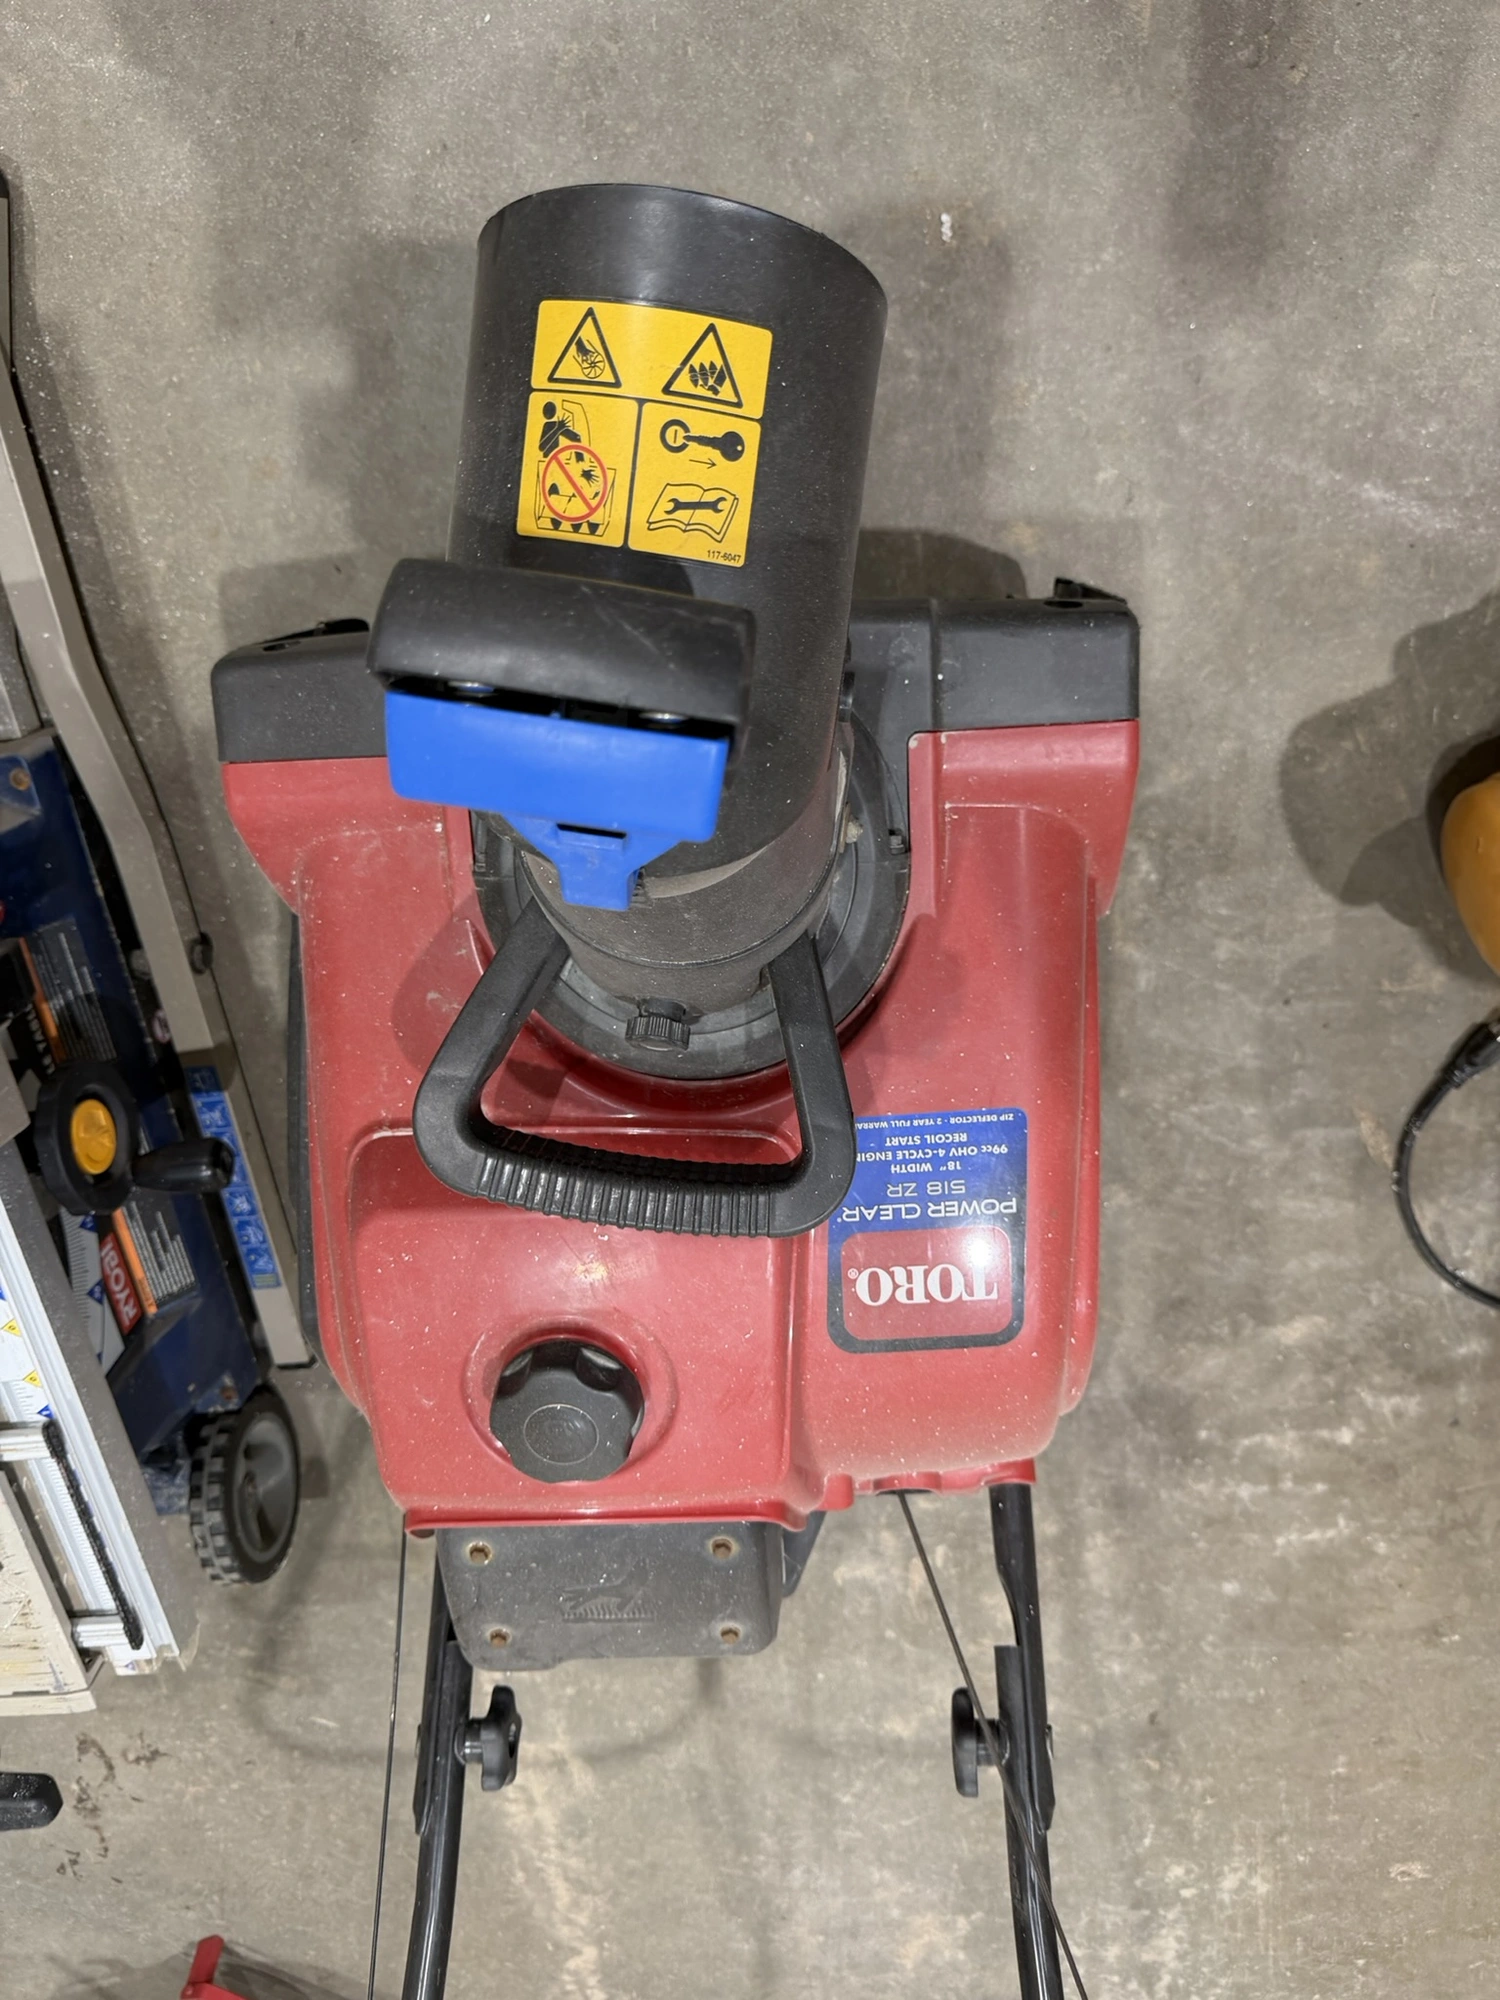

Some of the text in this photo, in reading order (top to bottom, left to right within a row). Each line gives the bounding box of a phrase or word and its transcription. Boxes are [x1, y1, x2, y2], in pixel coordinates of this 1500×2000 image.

[707, 550, 741, 563] 117-6047
[912, 1118, 935, 1126] YEAR
[950, 1114, 997, 1125] DEFLECTOR
[999, 1113, 1014, 1121] ZIP
[855, 1122, 888, 1130] WARRA
[890, 1120, 910, 1128] FULL
[885, 1132, 967, 1146] RECOIL START
[896, 1147, 945, 1160] 4-CYCLE
[949, 1145, 977, 1157] OHV
[981, 1143, 1008, 1154] 99cc
[891, 1163, 932, 1173] WIDTH
[886, 1179, 965, 1197] 518 ZR
[928, 1198, 1017, 1217] POWER
[100, 1242, 138, 1325] RYOBI
